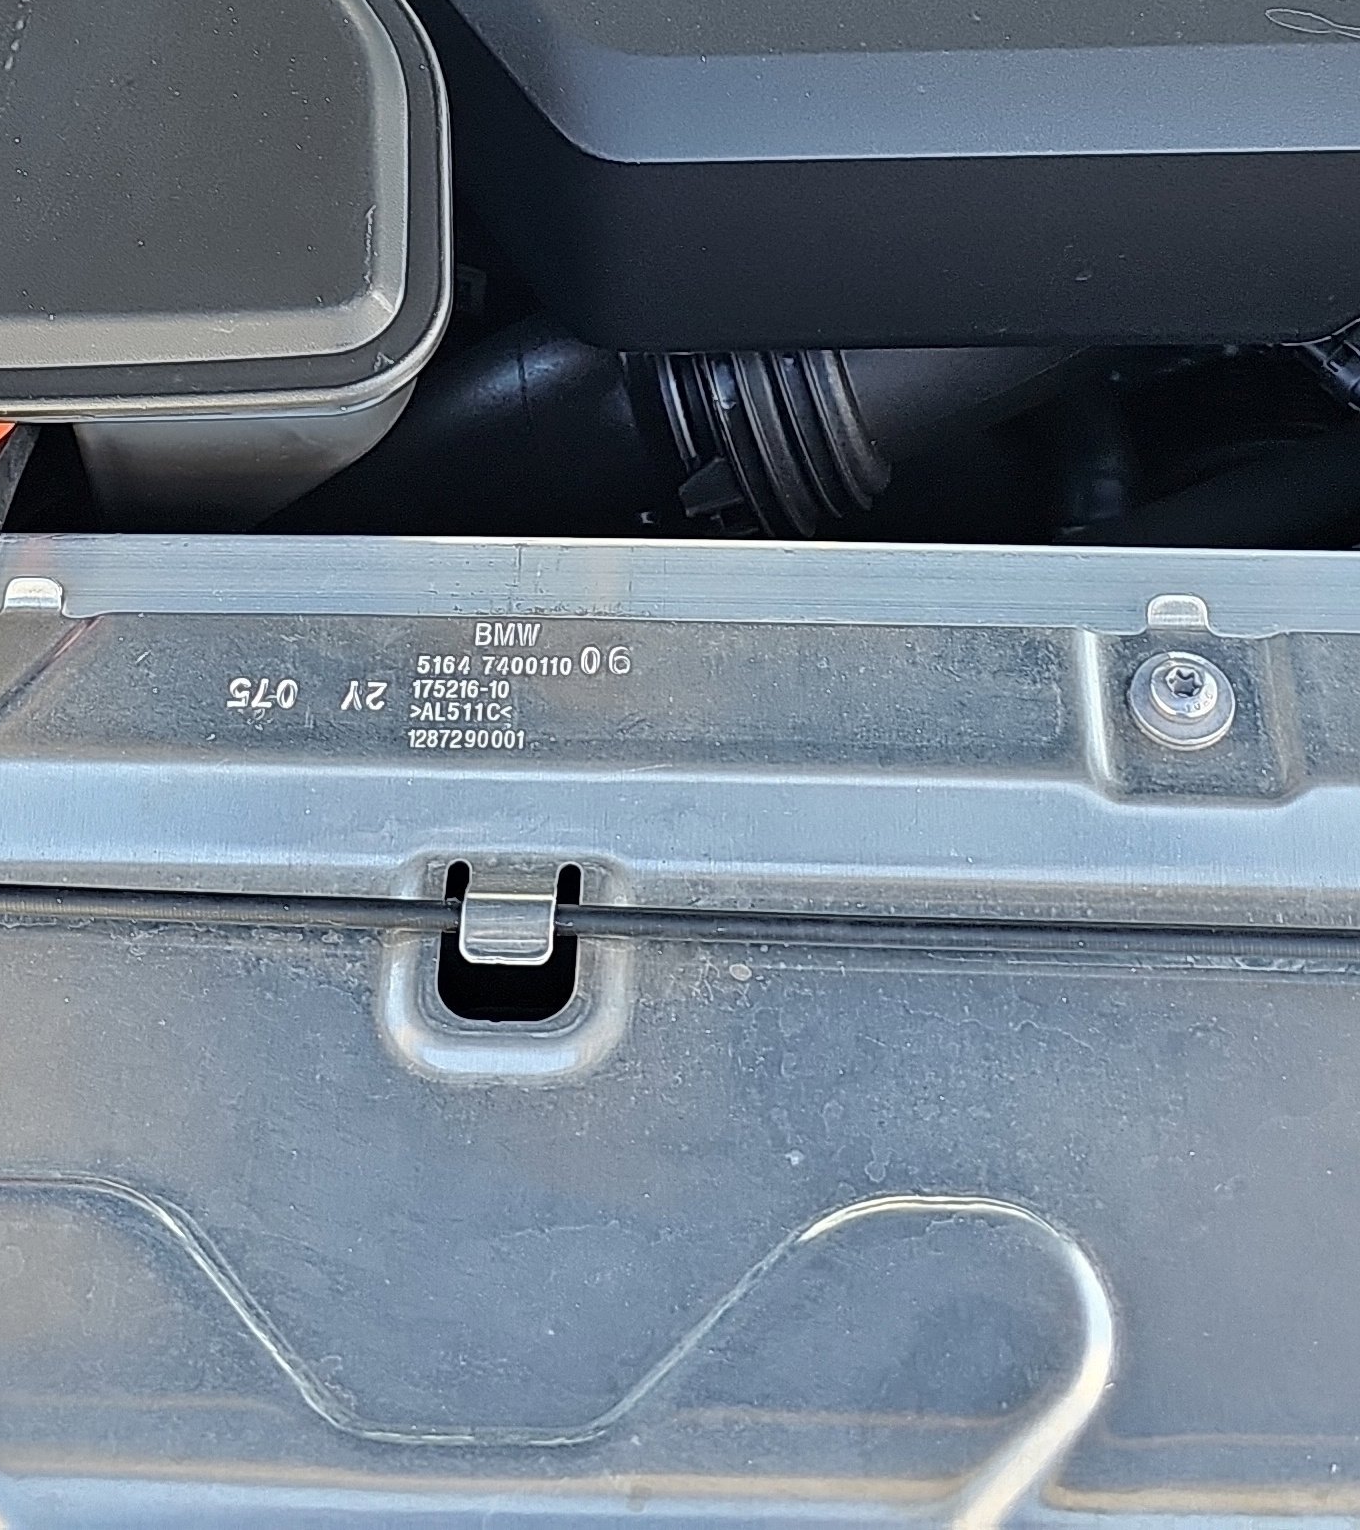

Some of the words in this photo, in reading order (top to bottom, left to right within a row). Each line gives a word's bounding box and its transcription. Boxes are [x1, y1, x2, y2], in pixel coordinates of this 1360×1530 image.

[474, 622, 542, 647] BMW
[416, 655, 471, 676] 5164
[483, 656, 572, 676] 7400110
[580, 646, 632, 675] 06
[226, 677, 298, 710] 075
[412, 679, 511, 700] 175216-10
[407, 728, 526, 750] 1287290001
